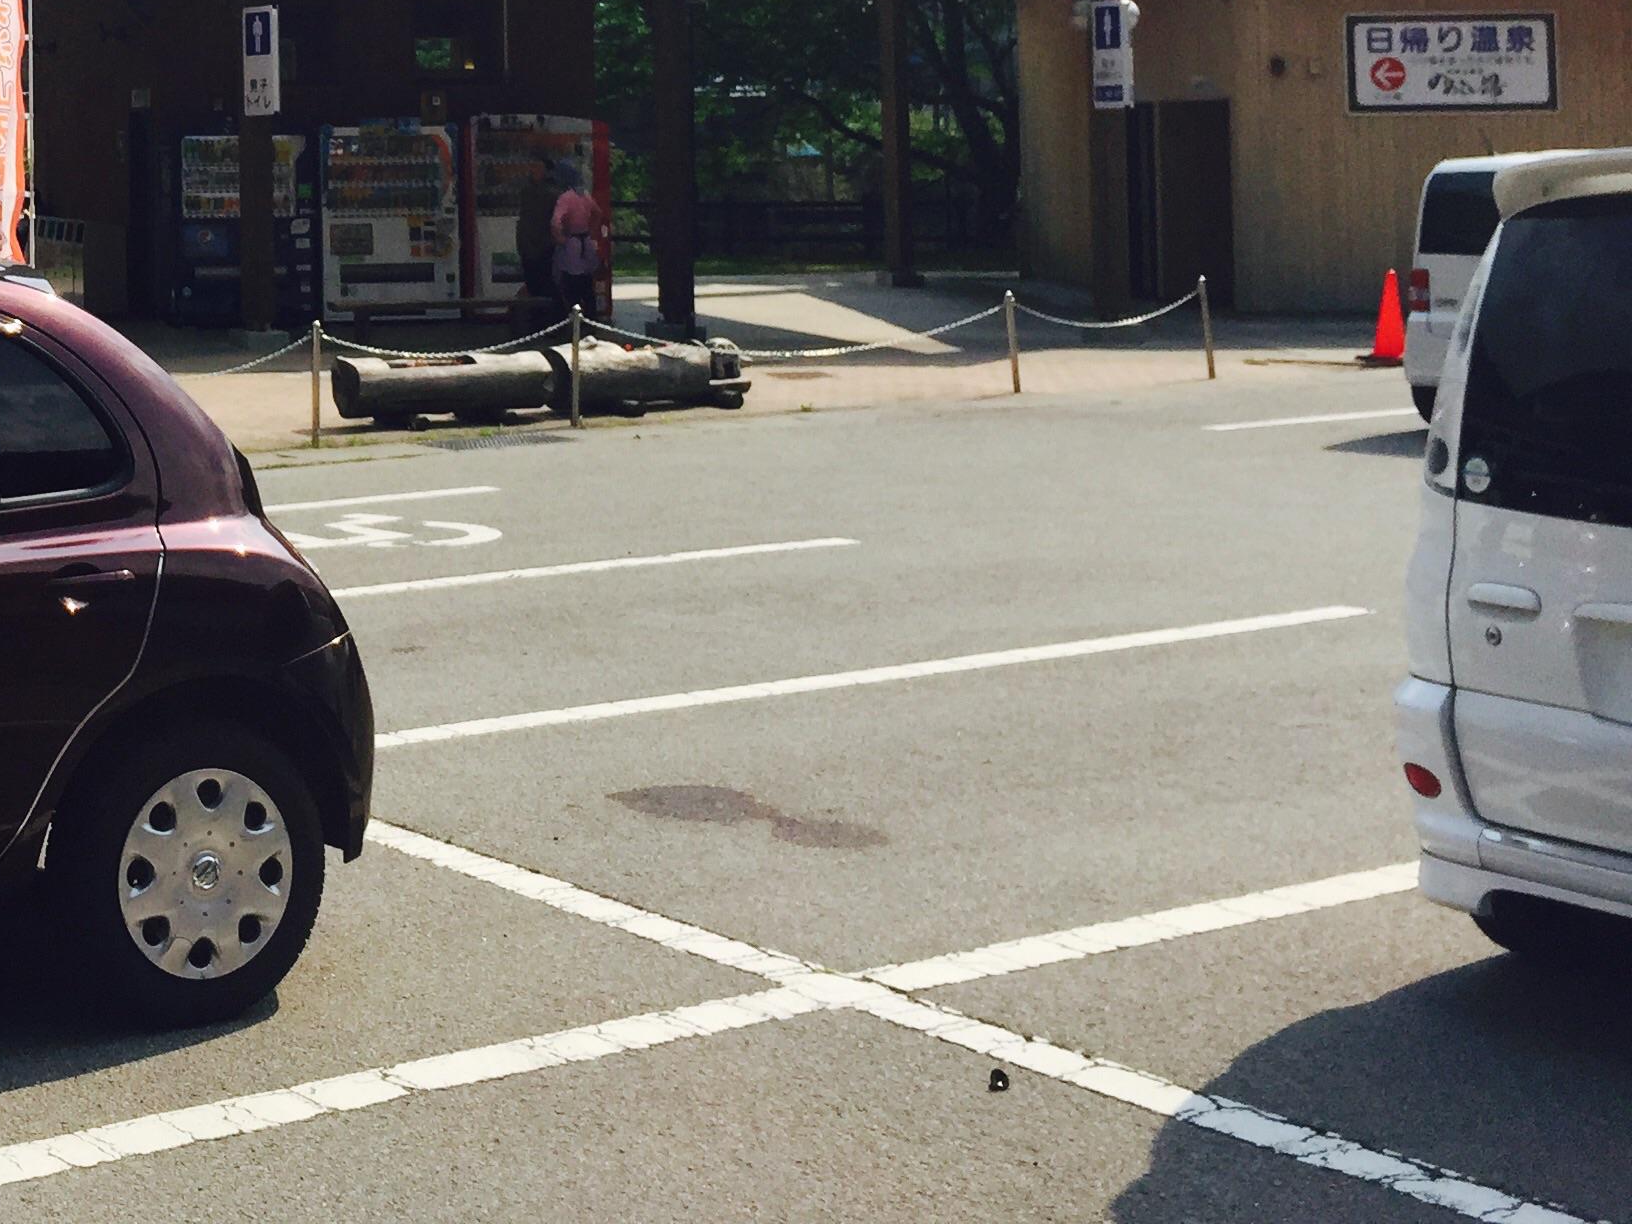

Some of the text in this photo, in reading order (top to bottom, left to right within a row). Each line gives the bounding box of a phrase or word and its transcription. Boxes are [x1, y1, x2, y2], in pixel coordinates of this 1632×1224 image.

[1366, 25, 1536, 54] 日帰り温泉
